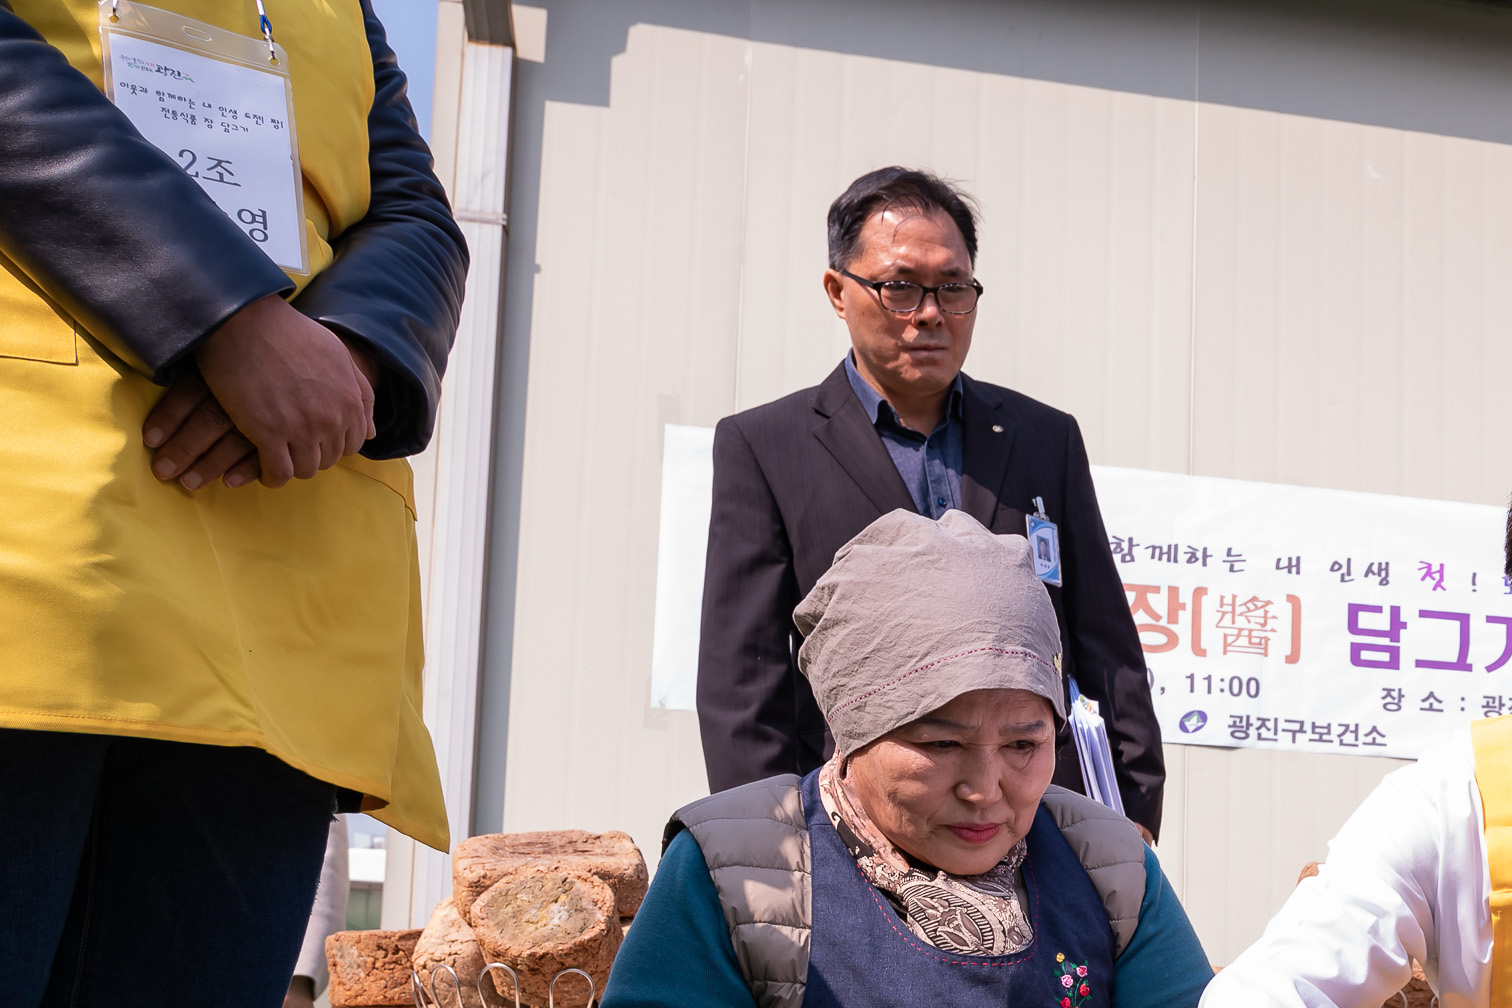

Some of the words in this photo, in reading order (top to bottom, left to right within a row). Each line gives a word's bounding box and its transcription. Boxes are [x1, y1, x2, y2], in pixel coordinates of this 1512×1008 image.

[120, 82, 148, 96] 이웃과
[155, 90, 196, 110] 함께하는
[218, 106, 238, 120] 인생
[160, 106, 197, 126] 전통식품
[203, 117, 213, 129] 장
[220, 121, 248, 133] 담그기
[178, 149, 241, 187] 2조
[1109, 535, 1246, 573] 함께하는
[1275, 555, 1301, 575] 내
[1329, 557, 1391, 586] 인생
[1185, 673, 1260, 699] 11:00
[1227, 713, 1388, 748] 광진구보건소
